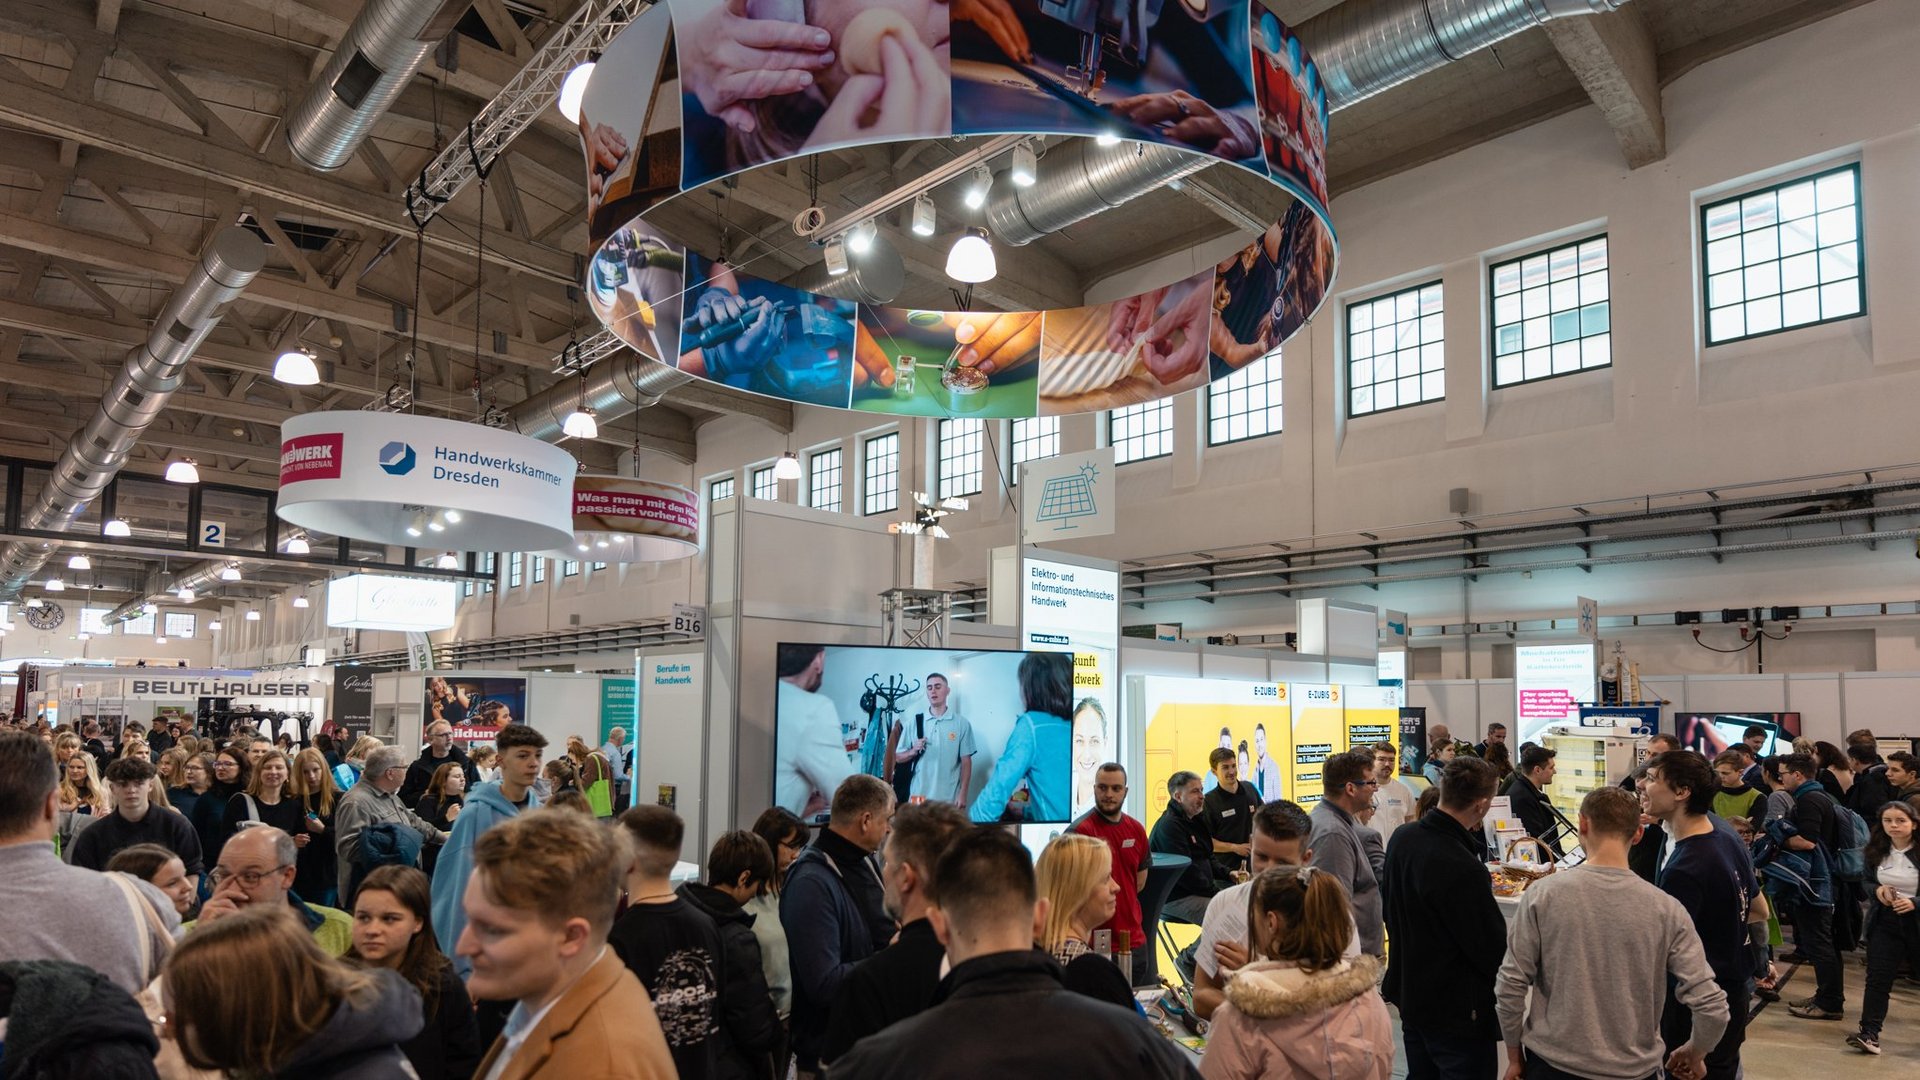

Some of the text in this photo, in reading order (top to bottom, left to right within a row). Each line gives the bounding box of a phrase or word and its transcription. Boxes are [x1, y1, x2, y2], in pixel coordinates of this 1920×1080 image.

[435, 446, 561, 486] Handwerkskammer
[434, 466, 499, 488] Dresden
[577, 493, 608, 502] Was
[613, 497, 643, 505] man
[647, 500, 666, 509] mit
[668, 503, 684, 513] den
[577, 505, 636, 515] passiert
[639, 509, 676, 521] vorher
[678, 515, 687, 524] im
[204, 524, 220, 543] 2
[1032, 567, 1074, 582] Elektro- und
[1032, 582, 1114, 600] Informationstechnisches
[1032, 596, 1066, 608] Handwerk
[675, 617, 700, 633] B16
[1074, 655, 1095, 666] kunft
[657, 664, 690, 673] Berufe im
[655, 676, 691, 684] Handwerk
[1075, 673, 1100, 685] dwerk
[133, 680, 310, 696] BEUTLHAUSER
[1254, 687, 1277, 696] E-ZUBIS
[1308, 691, 1329, 699] E-ZUBIS
[454, 728, 499, 738] ildun
[1404, 726, 1416, 734] 2.0
